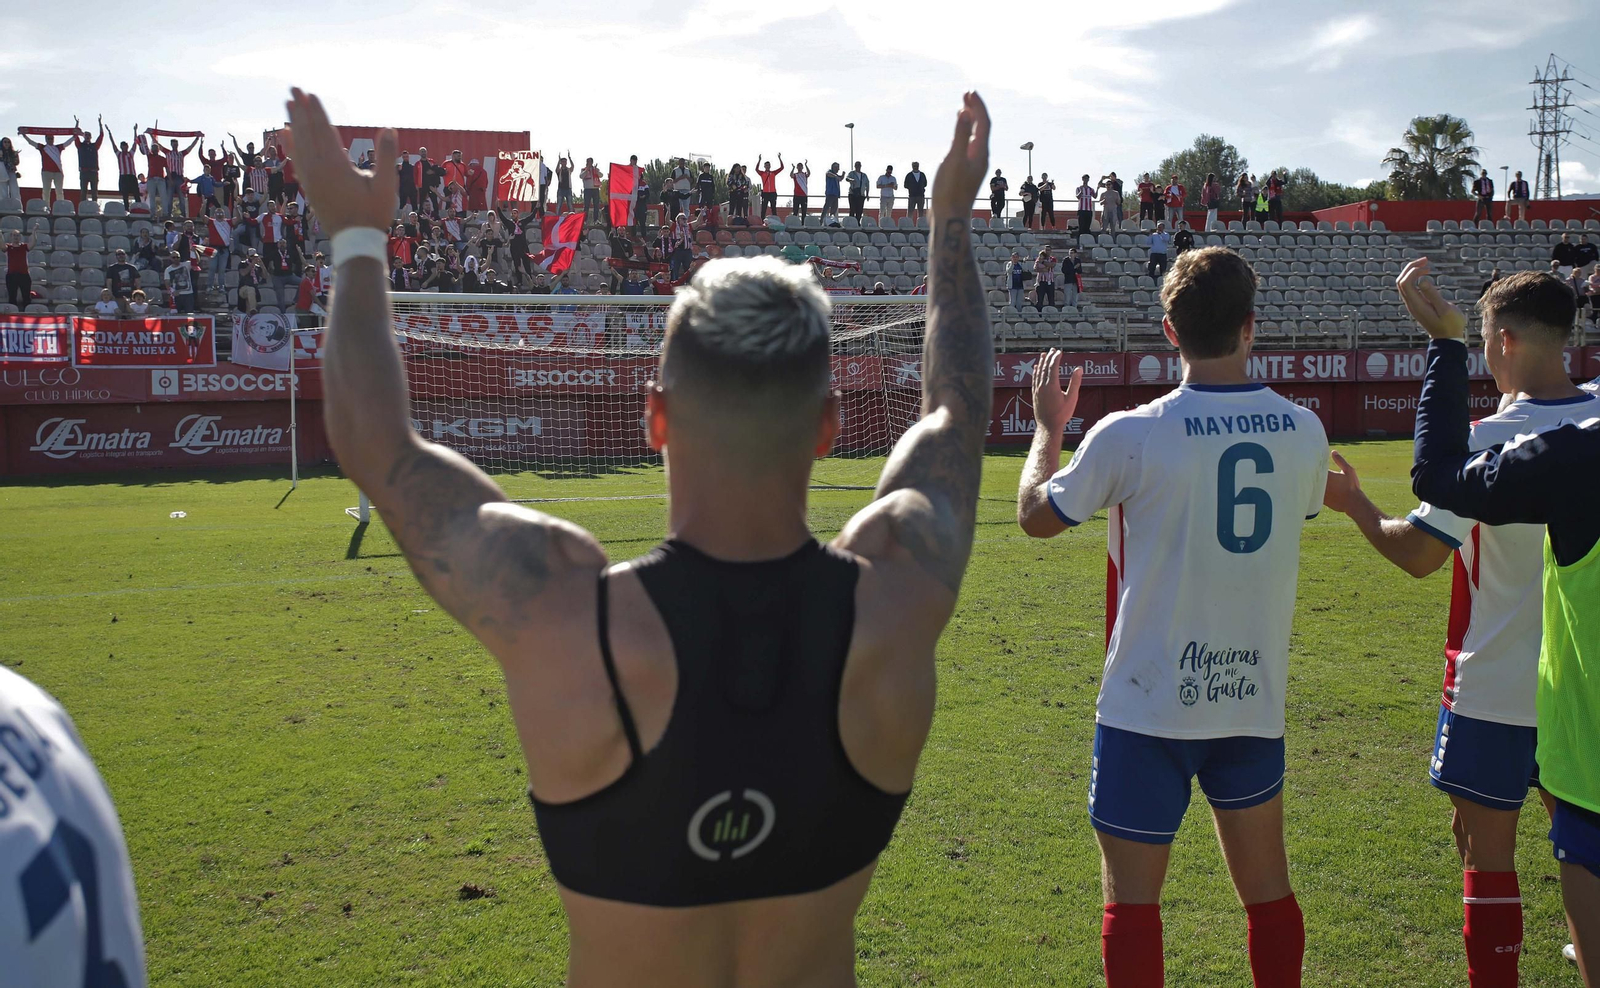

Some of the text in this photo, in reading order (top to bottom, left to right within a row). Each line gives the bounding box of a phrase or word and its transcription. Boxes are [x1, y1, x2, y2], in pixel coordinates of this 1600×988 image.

[80, 330, 176, 345] KOMANDO
[80, 345, 177, 355] FUENTE NUEVA
[1058, 359, 1119, 375] aixBank
[1302, 355, 1347, 379] SUR
[0, 367, 81, 387] UEGO
[182, 373, 299, 392] BESOCCER
[514, 368, 616, 387] BESOCCER
[24, 388, 111, 401] CLUB HÍPICO
[1364, 394, 1418, 412] Hospit
[432, 416, 542, 438] KGM
[1184, 413, 1296, 437] MAYORGA
[136, 449, 163, 457] transporte
[1216, 441, 1275, 554] 6
[1178, 640, 1262, 681] Algeciras
[1224, 667, 1240, 678] me
[1207, 672, 1259, 703] Gusta
